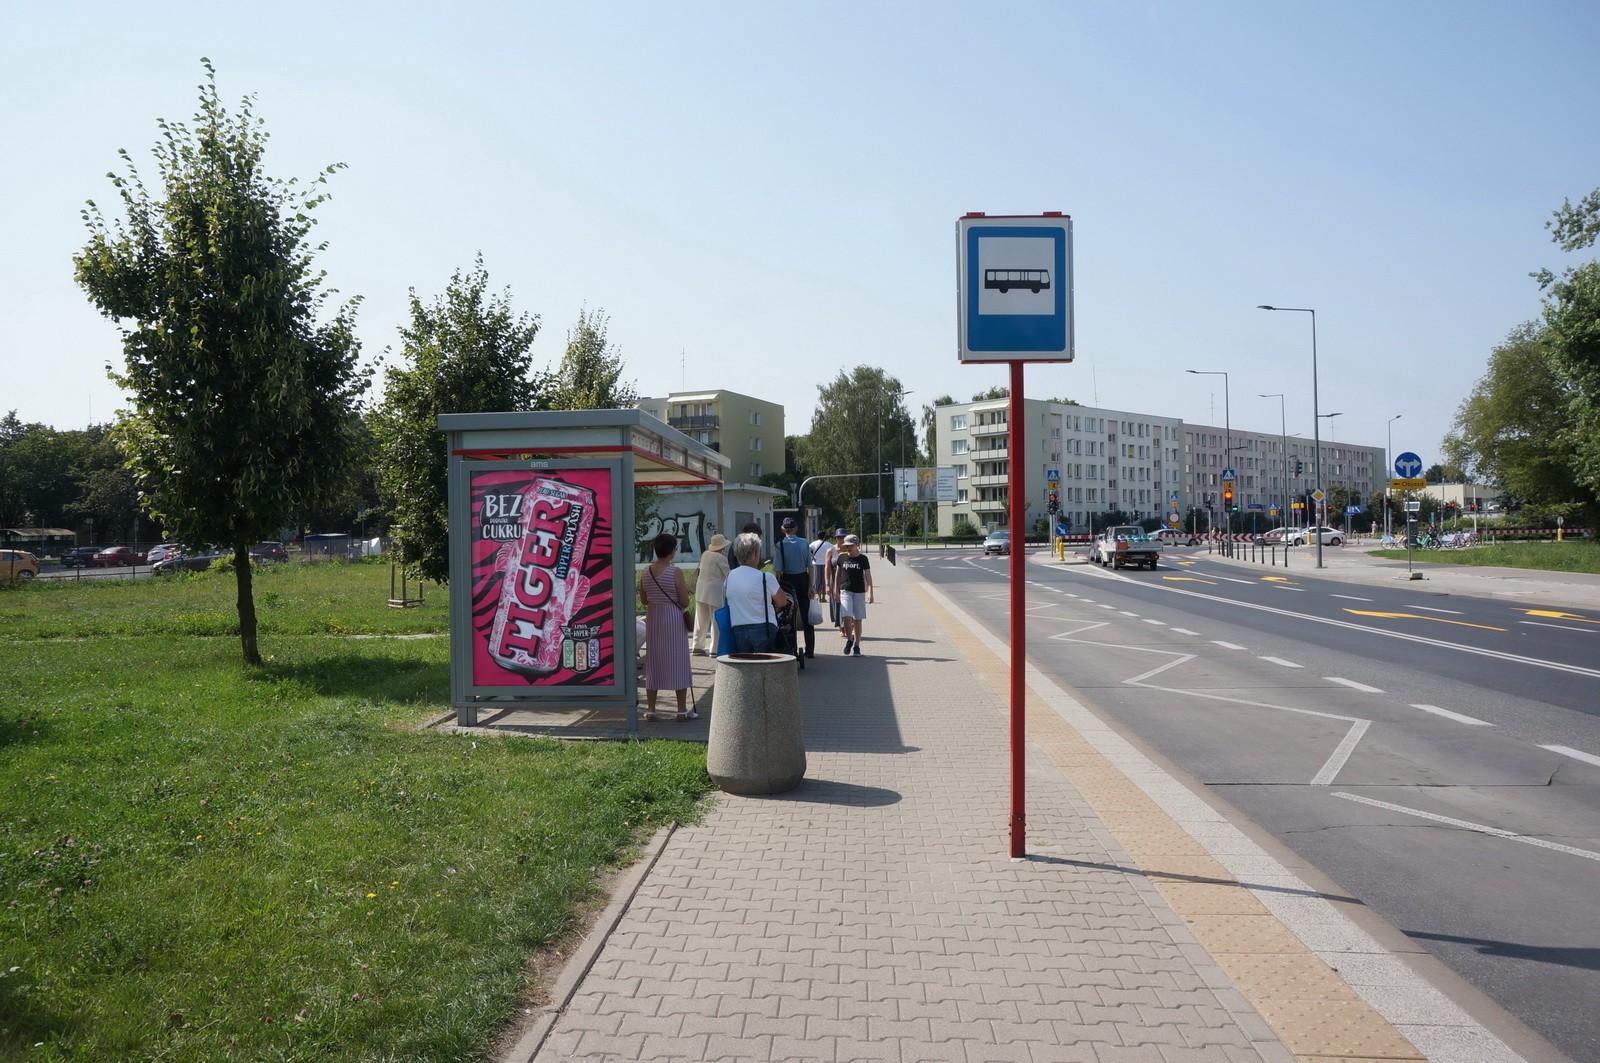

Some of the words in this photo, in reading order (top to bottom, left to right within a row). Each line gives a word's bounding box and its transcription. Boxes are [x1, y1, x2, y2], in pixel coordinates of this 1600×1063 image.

[484, 494, 523, 518] BEZ
[482, 524, 522, 539] CUKRU
[556, 544, 572, 579] HYPER
[564, 504, 583, 544] SPLASH
[499, 500, 572, 659] TIGER
